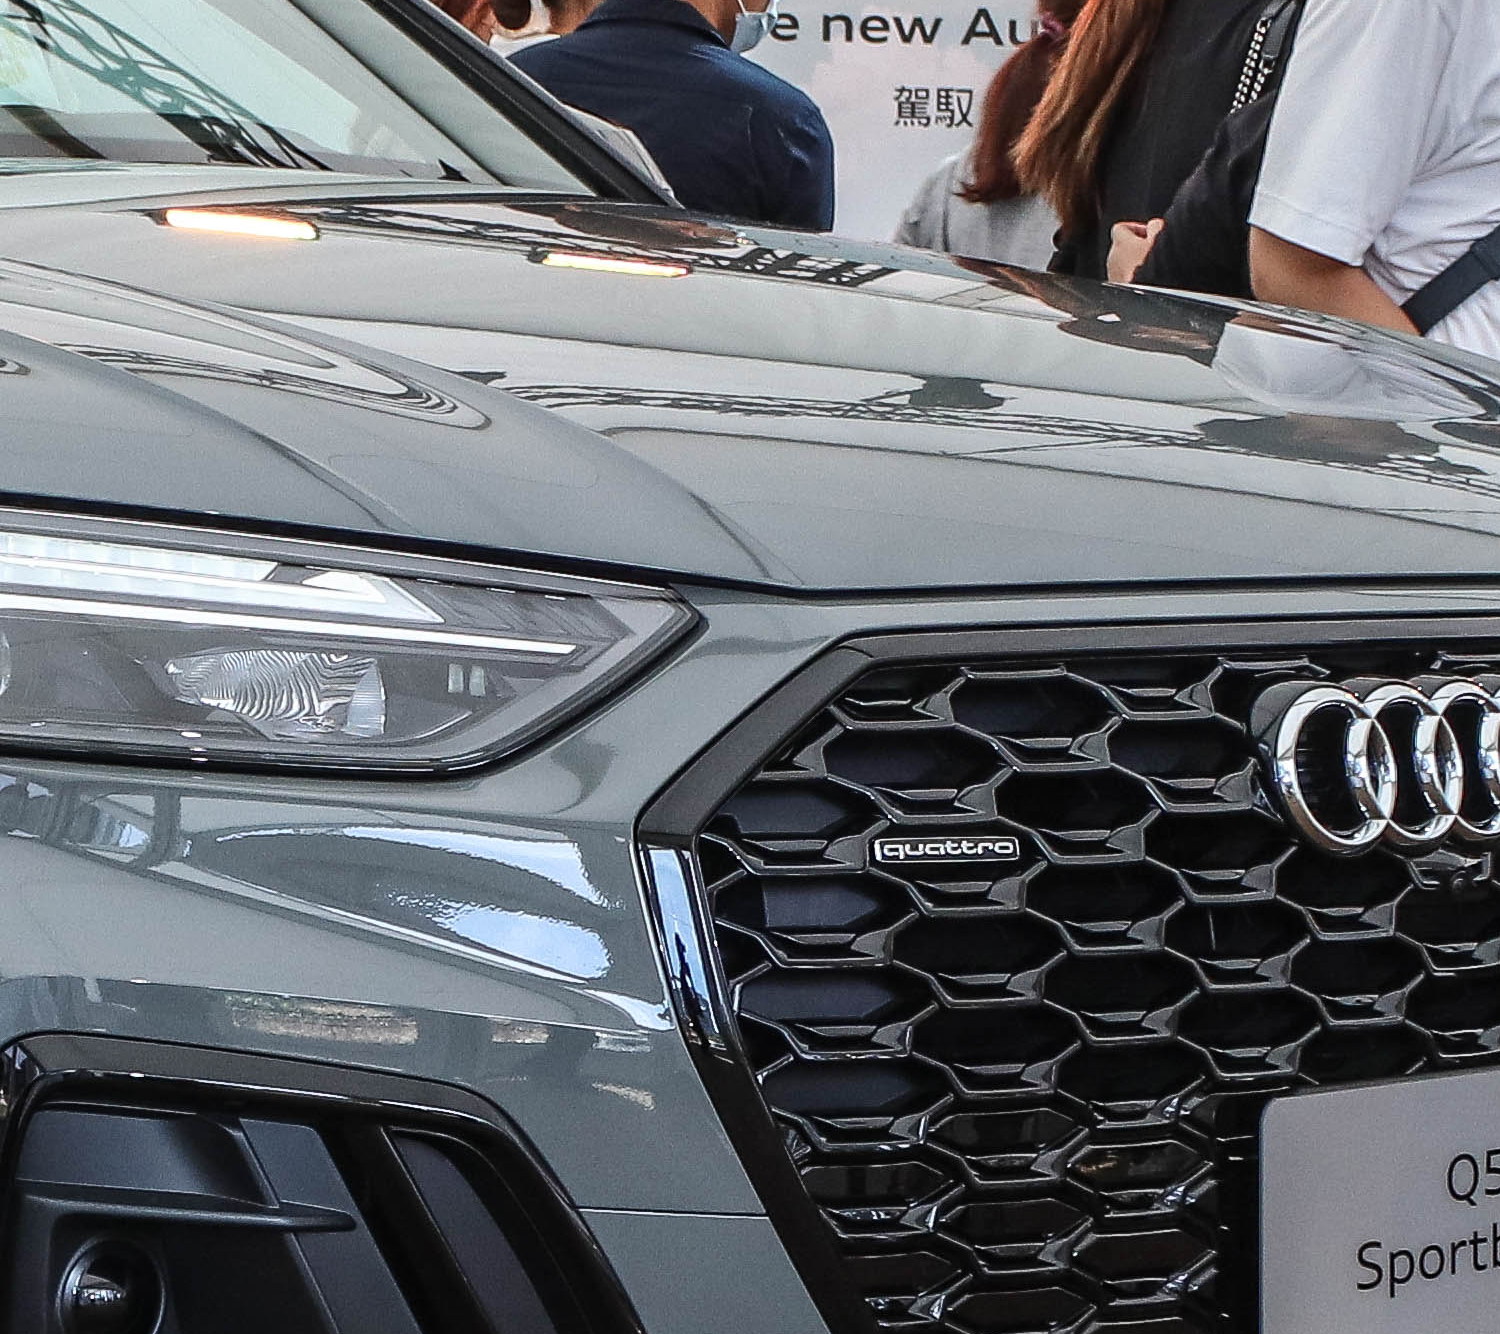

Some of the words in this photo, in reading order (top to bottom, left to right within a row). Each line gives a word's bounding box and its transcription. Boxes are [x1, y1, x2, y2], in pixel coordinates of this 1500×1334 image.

[822, 12, 943, 45] new
[961, 8, 1040, 46] Au
[893, 85, 974, 128] 駕馭
[883, 839, 1014, 859] quattro
